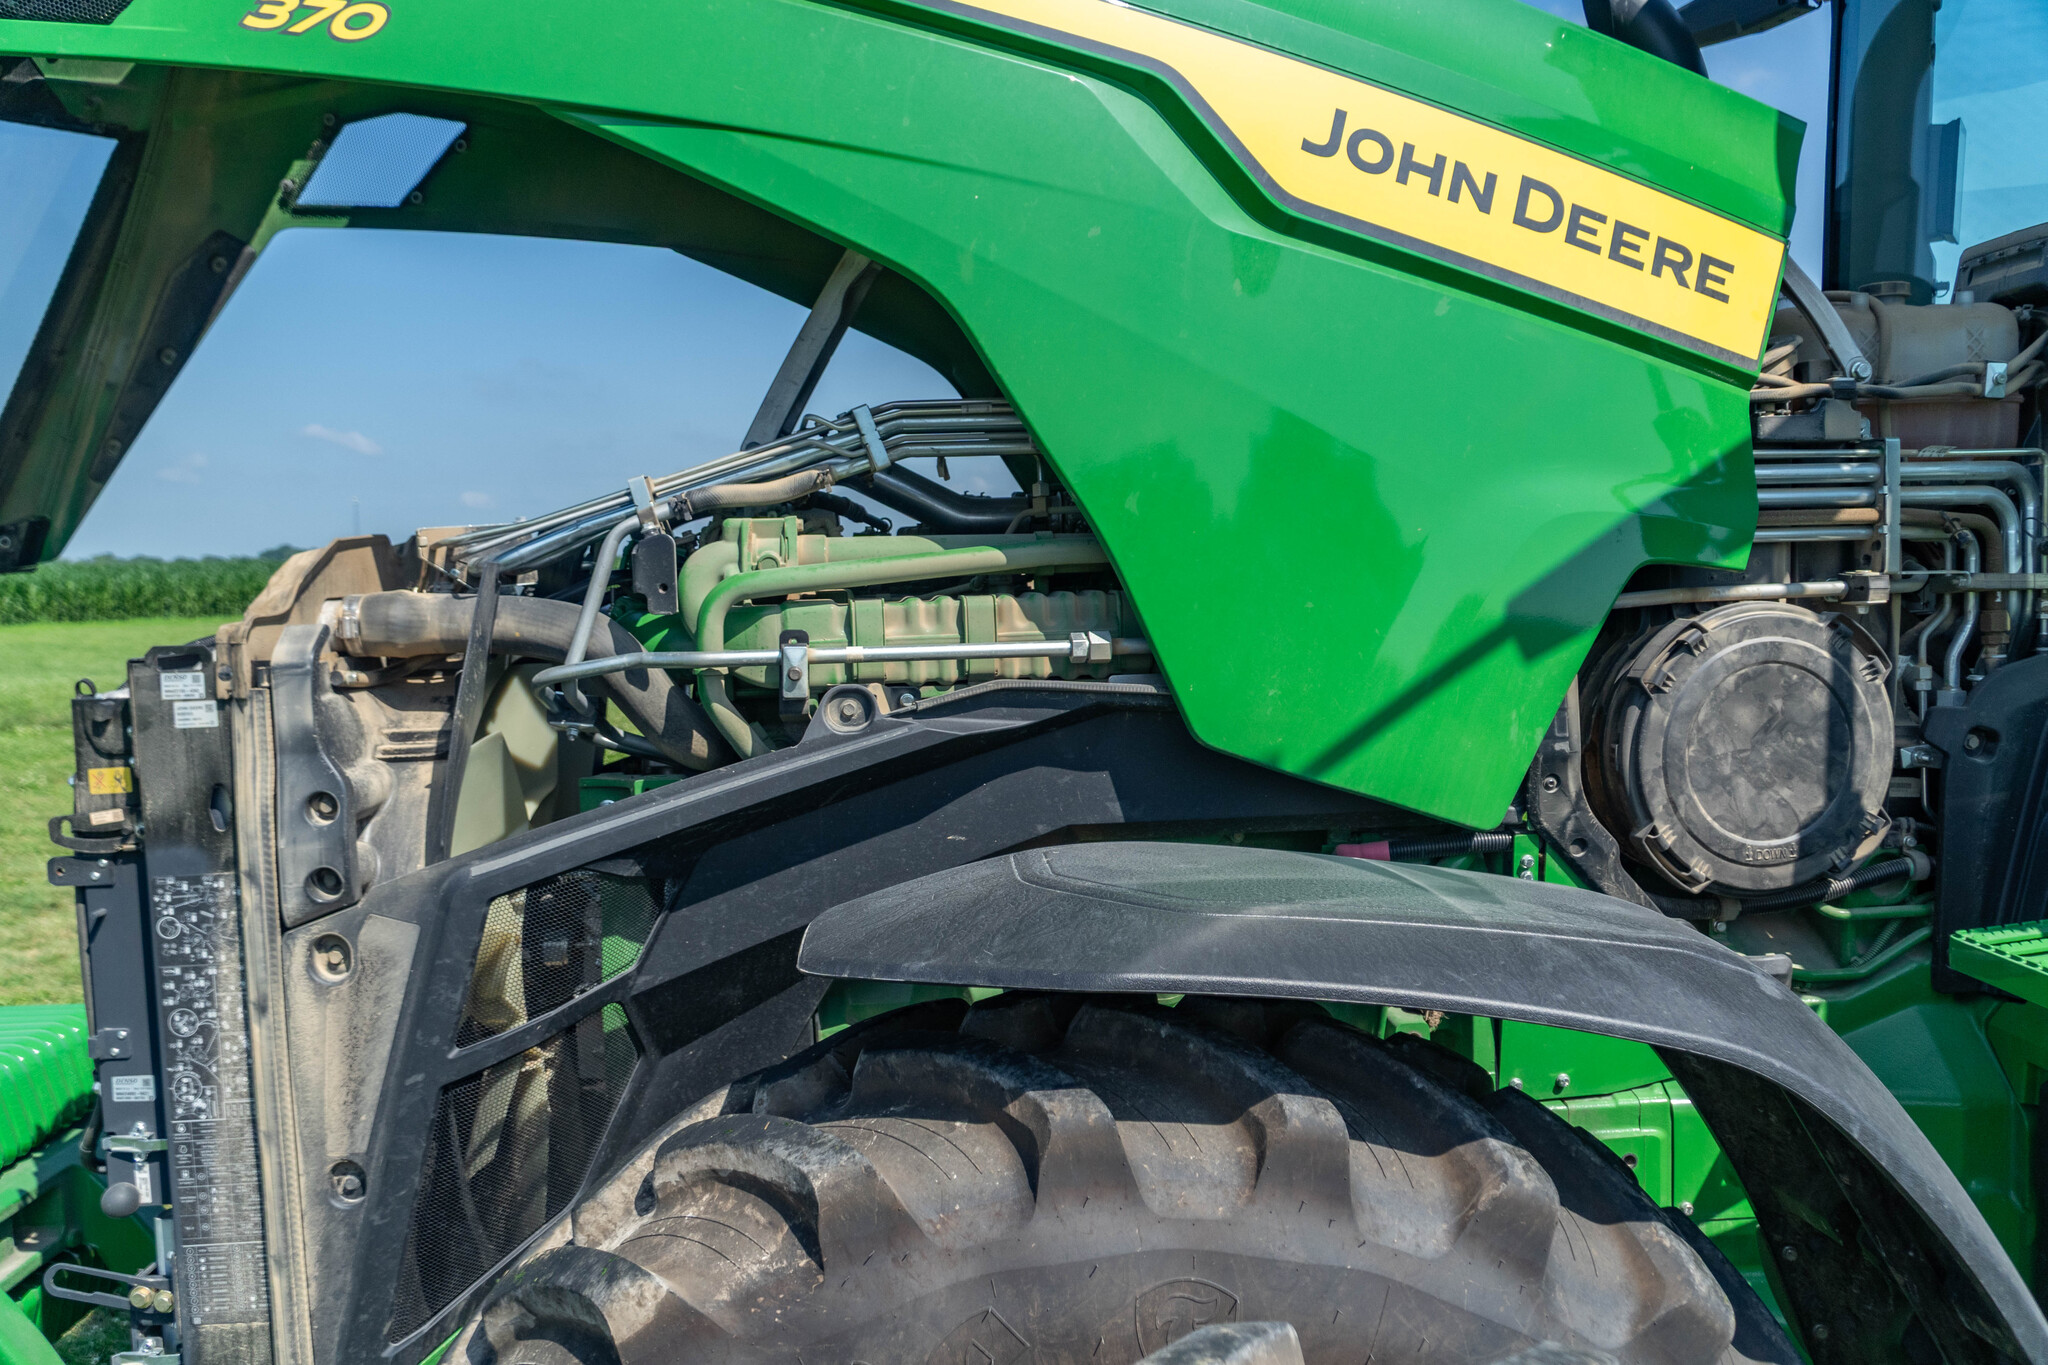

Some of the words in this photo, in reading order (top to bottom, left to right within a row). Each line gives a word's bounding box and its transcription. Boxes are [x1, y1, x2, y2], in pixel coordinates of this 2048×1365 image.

[238, 0, 392, 43] 370
[1300, 108, 1498, 215] JOHN
[1512, 175, 1736, 304] DEERE
[1756, 848, 1787, 861] DOWN
